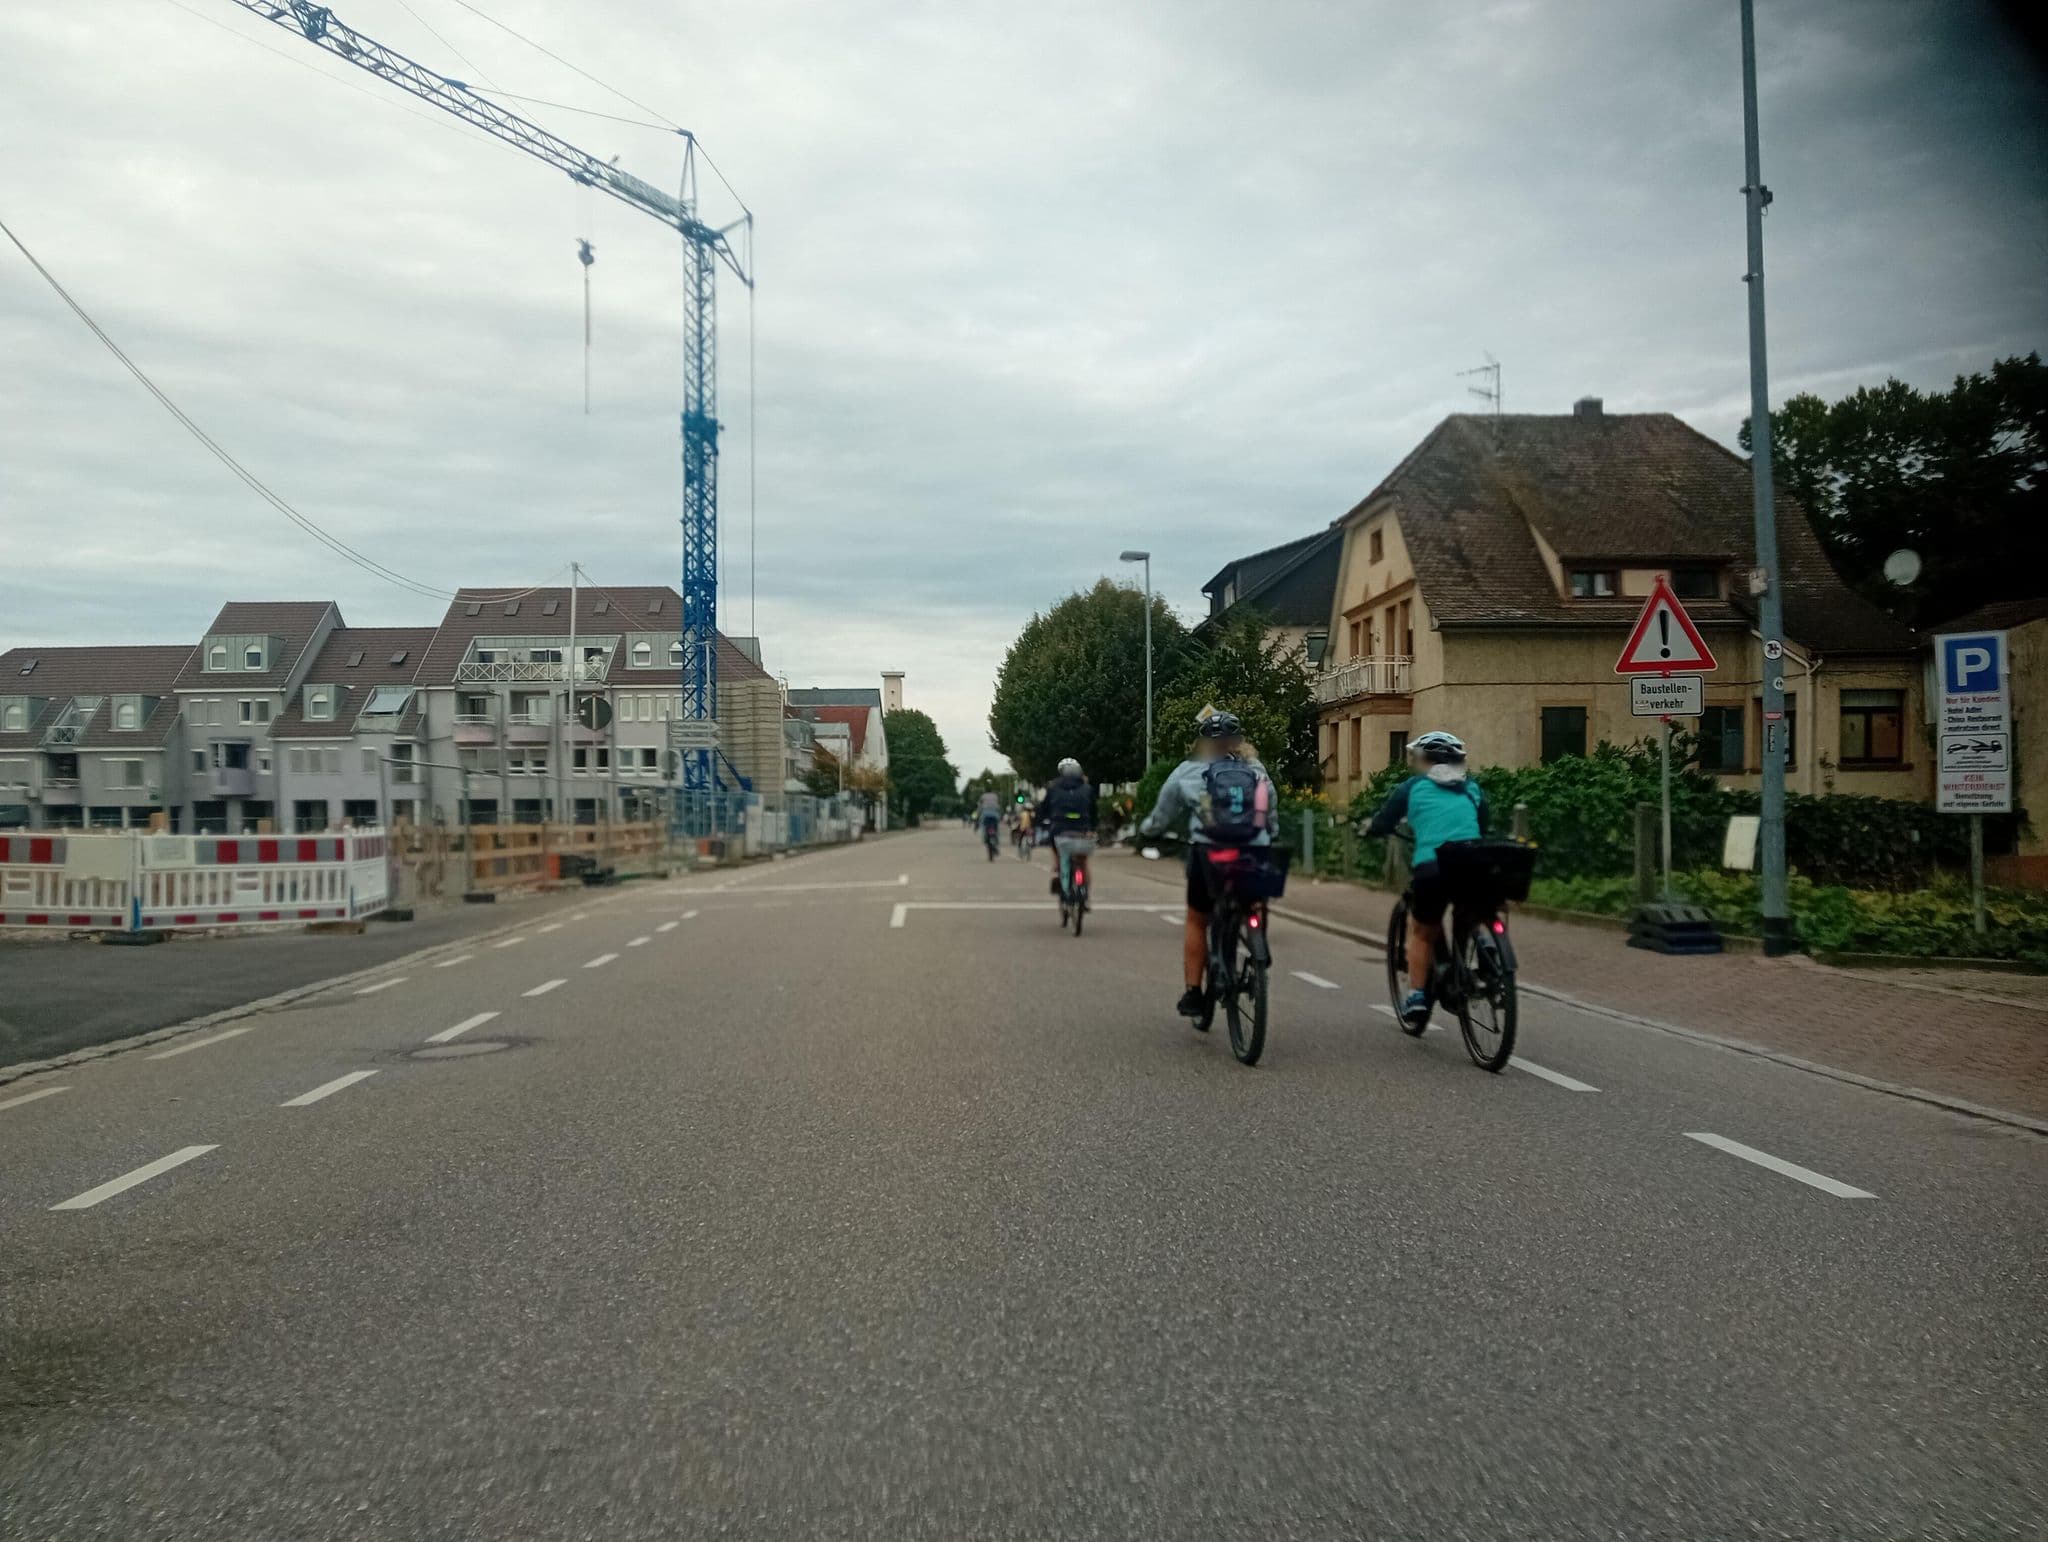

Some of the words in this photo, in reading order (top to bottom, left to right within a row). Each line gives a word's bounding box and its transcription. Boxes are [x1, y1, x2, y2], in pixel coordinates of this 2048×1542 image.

[1956, 647, 1991, 687] P
[1641, 683, 1692, 694] Baustellen-
[1649, 699, 1684, 709] verkehr
